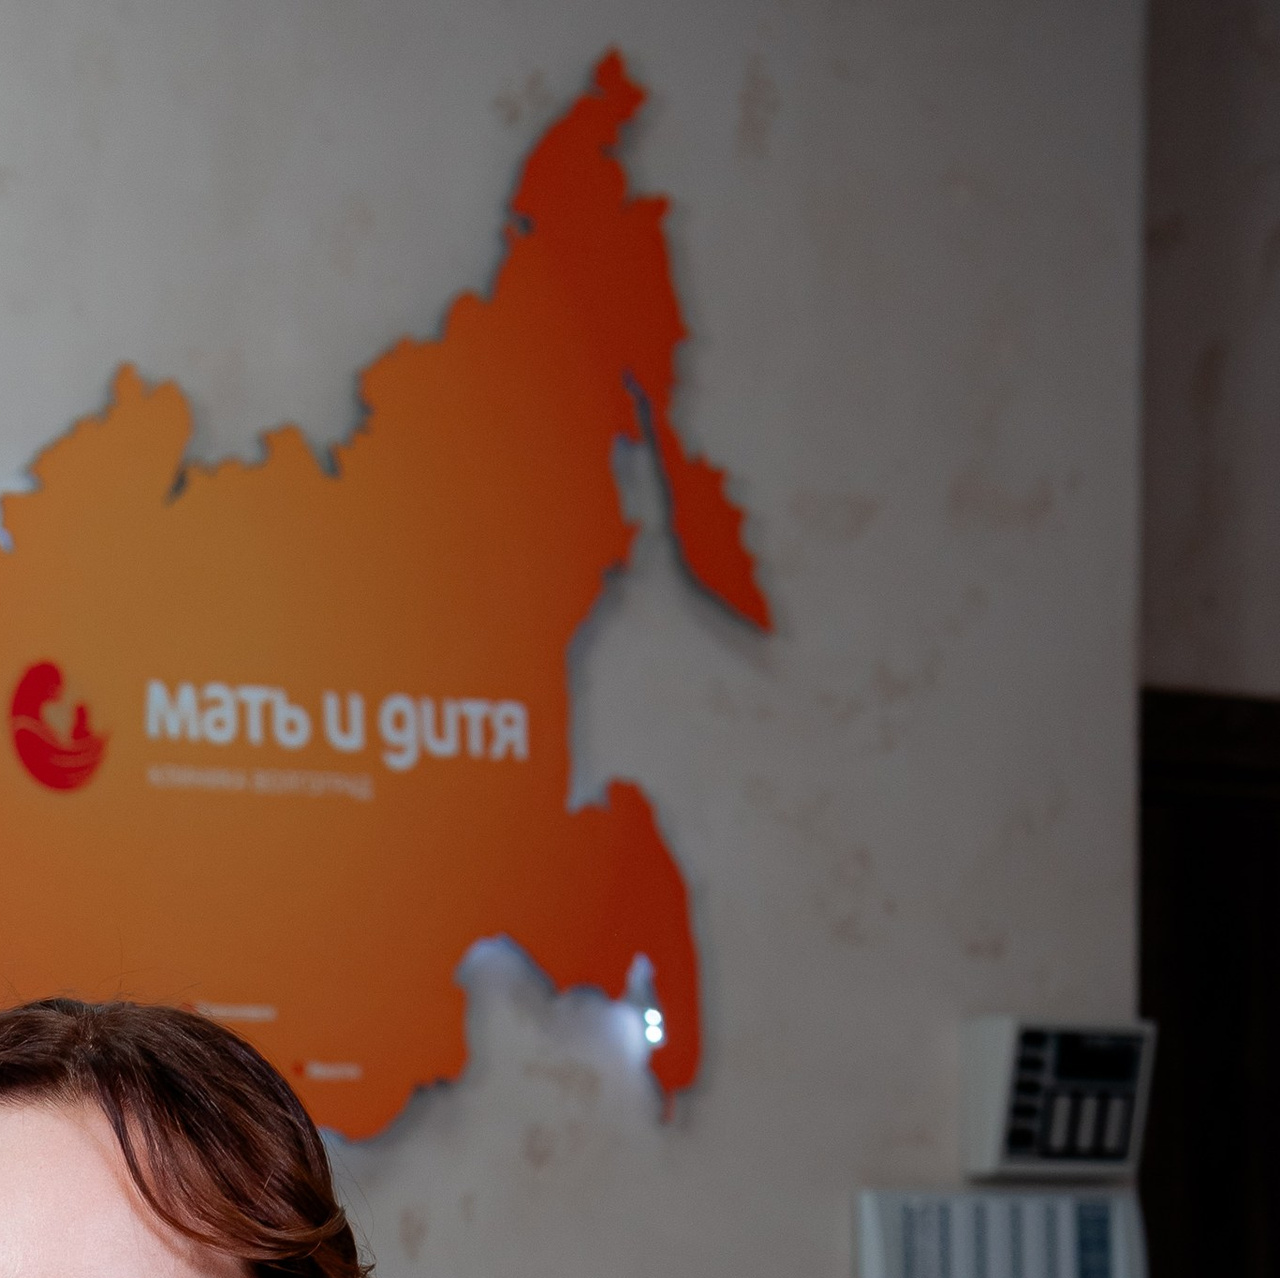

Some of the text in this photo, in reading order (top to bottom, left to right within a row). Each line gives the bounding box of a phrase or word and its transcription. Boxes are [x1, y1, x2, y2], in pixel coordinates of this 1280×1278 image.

[323, 691, 365, 752] и
[148, 765, 373, 799] КЛИНИКА ВОЛГОГРАД
